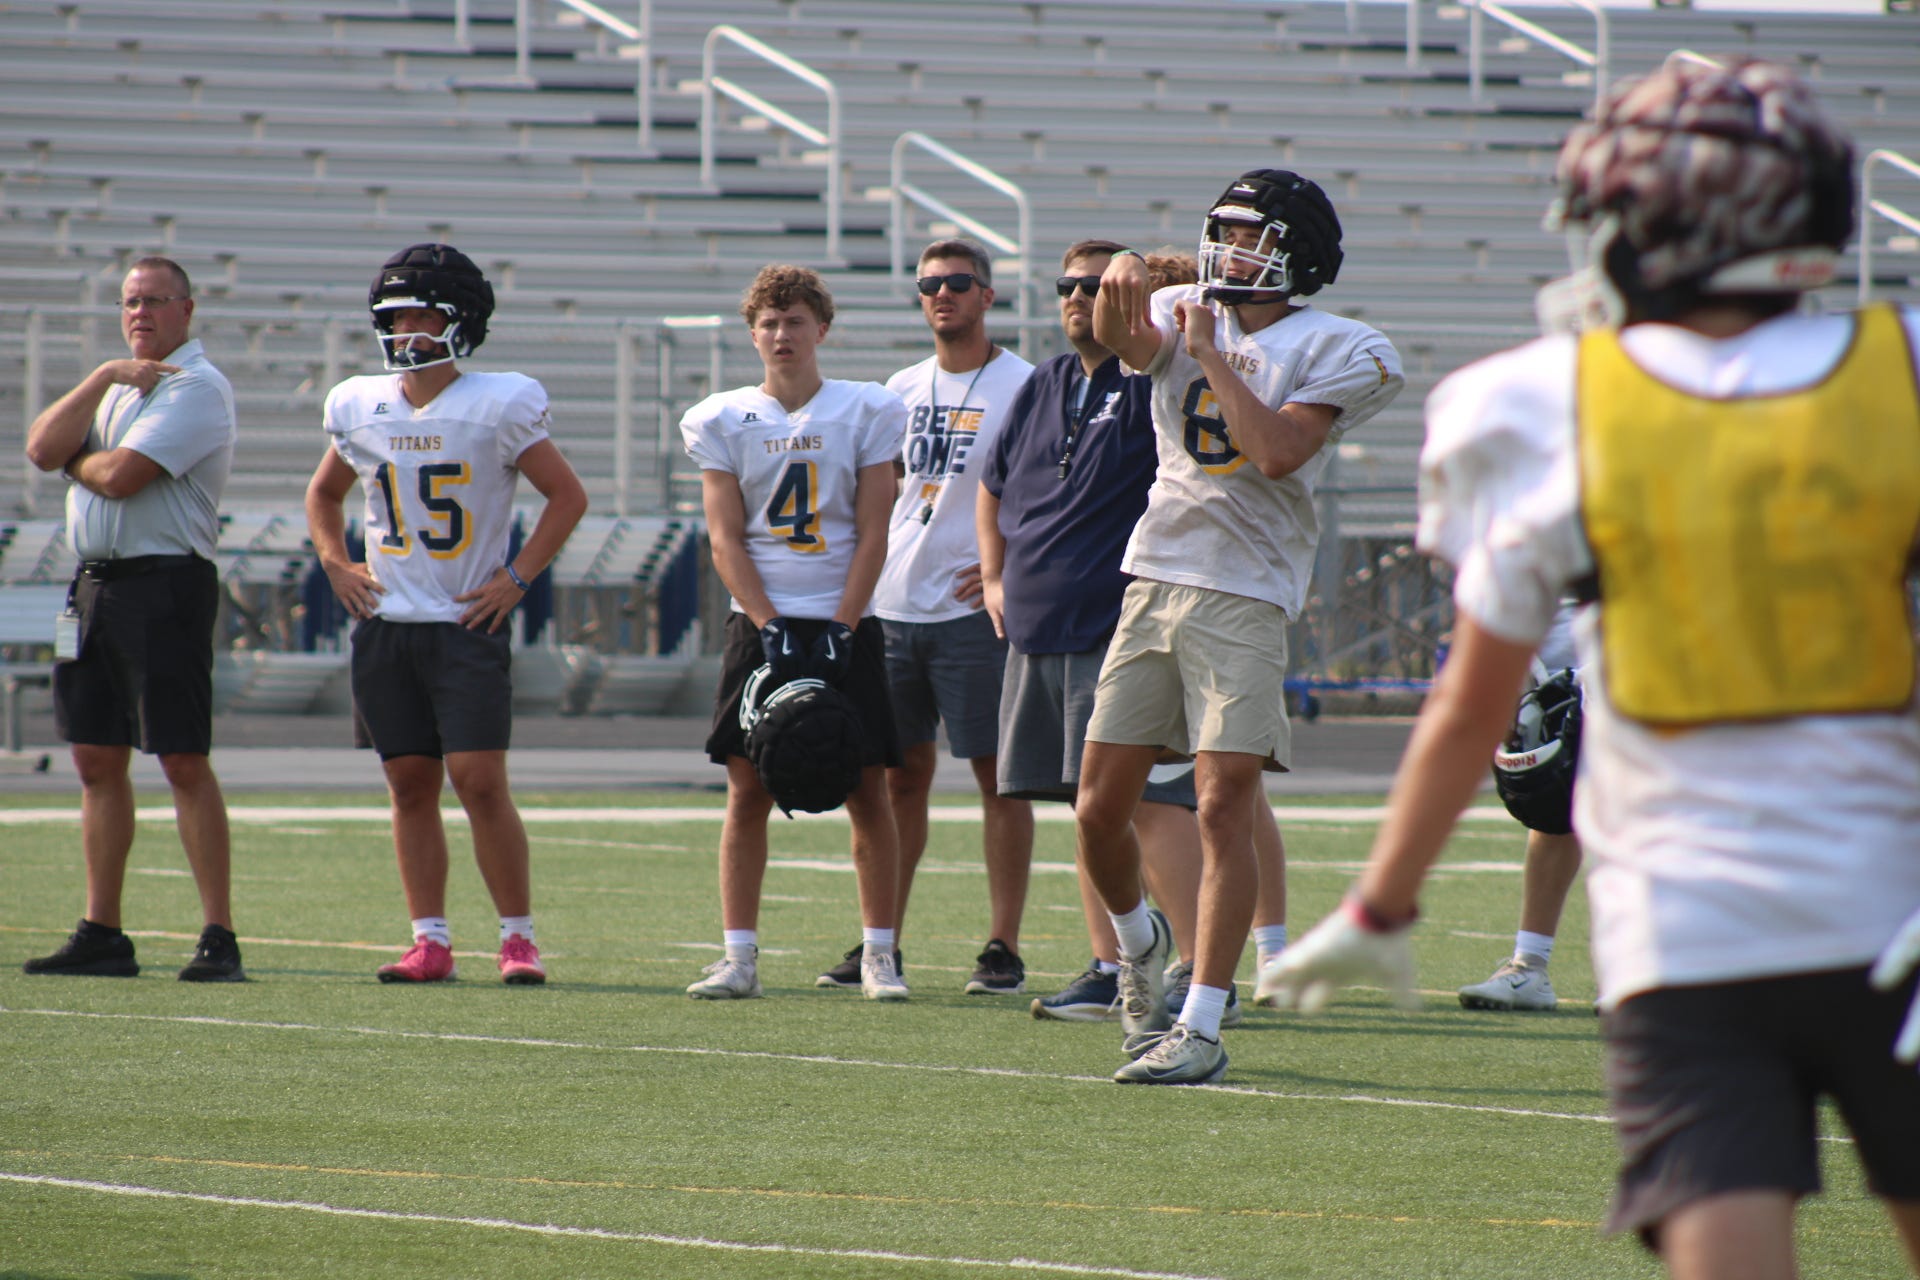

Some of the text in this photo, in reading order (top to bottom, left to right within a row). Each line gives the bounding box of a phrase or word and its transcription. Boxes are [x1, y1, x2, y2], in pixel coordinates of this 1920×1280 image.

[910, 404, 984, 435] BE THE
[388, 436, 442, 451] TITANS
[763, 435, 823, 454] TITANS
[909, 434, 975, 476] ONE
[374, 460, 474, 560] 15
[766, 459, 827, 554] 4
